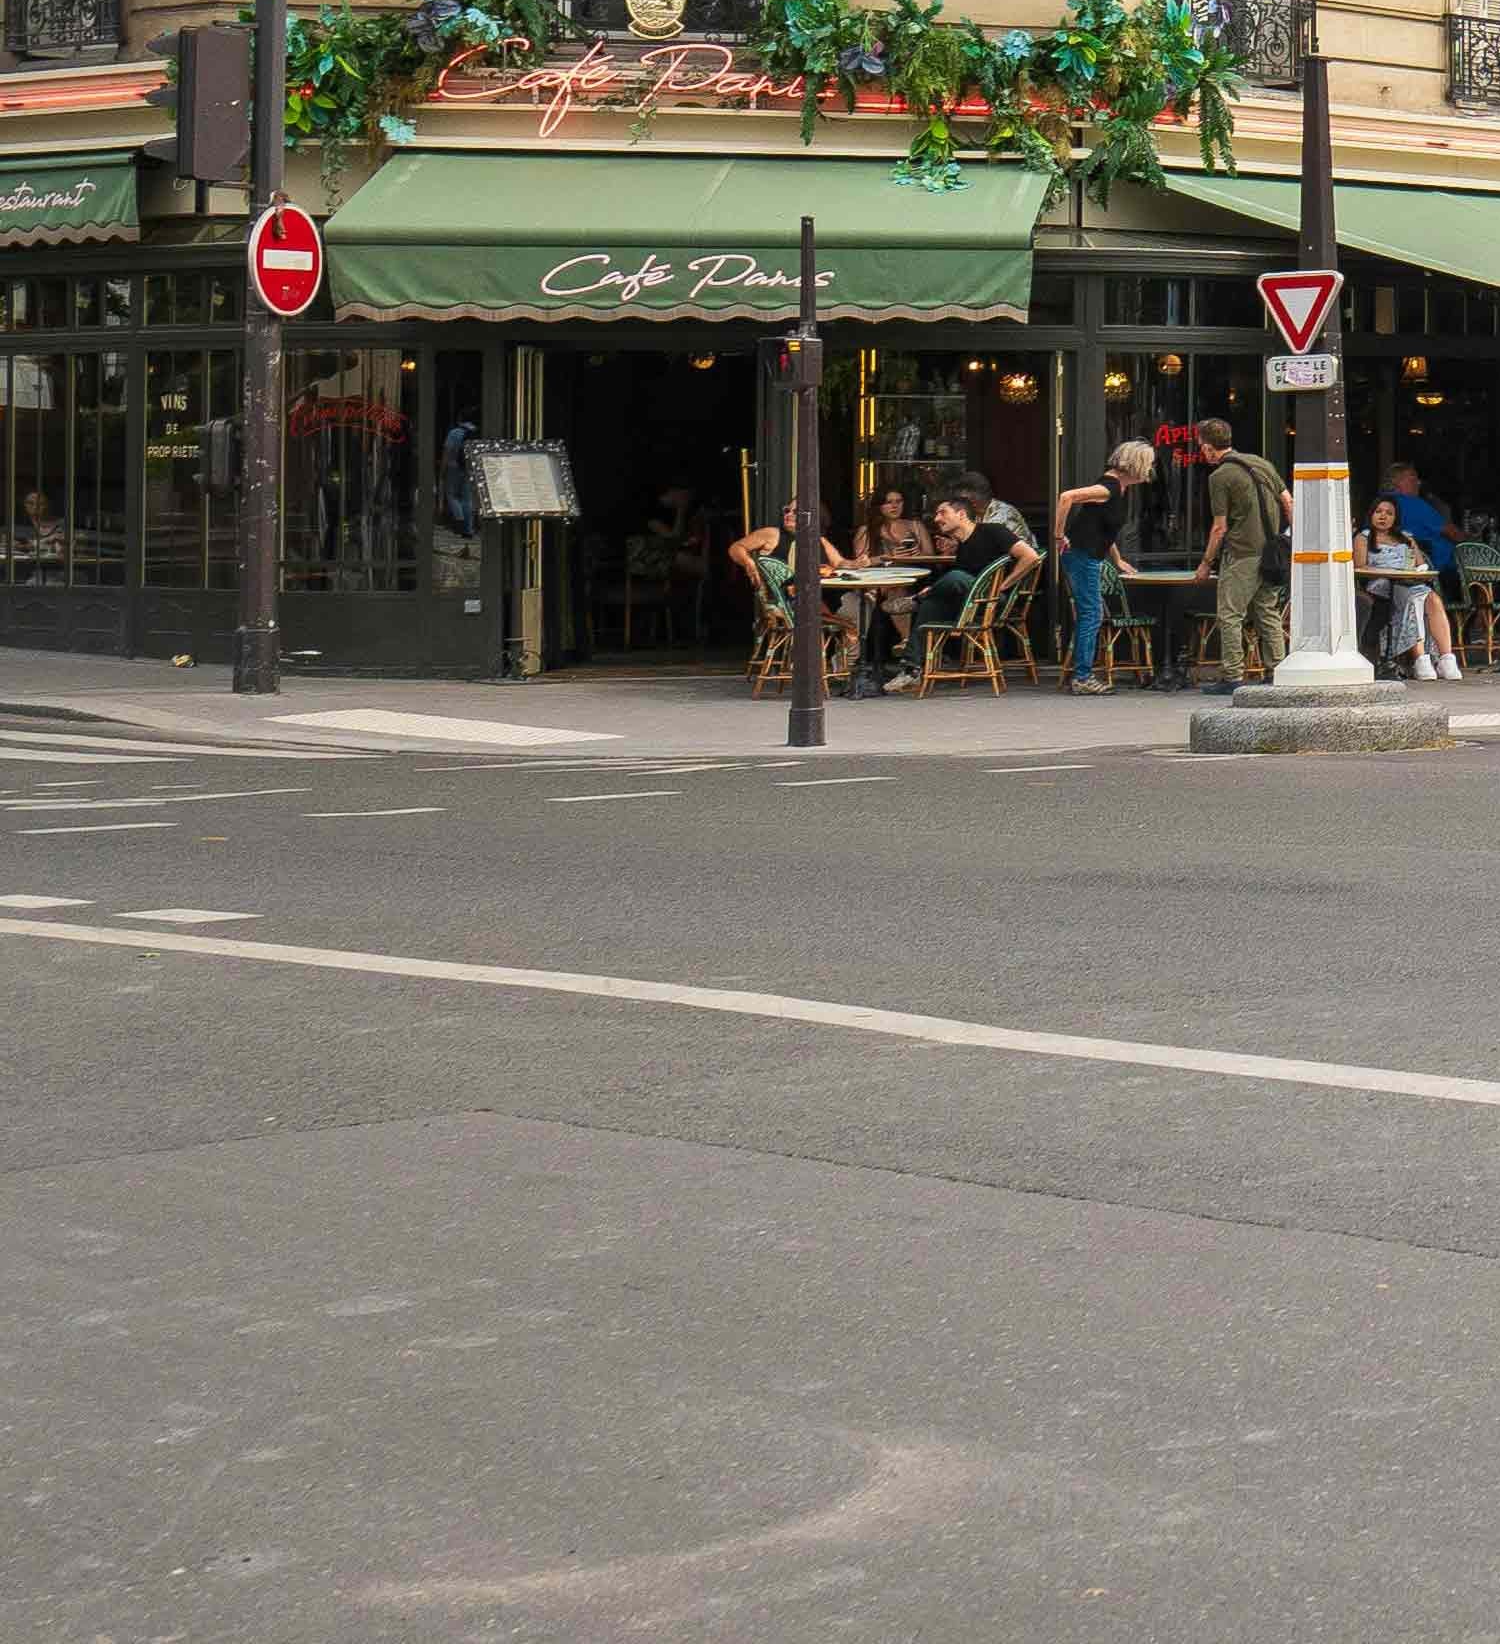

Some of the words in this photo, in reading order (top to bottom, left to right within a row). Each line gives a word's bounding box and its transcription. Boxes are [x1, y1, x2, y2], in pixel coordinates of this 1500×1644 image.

[437, 37, 622, 138] Café
[637, 43, 836, 112] Pari
[0, 177, 97, 211] estaurant
[540, 254, 674, 301] Café
[1314, 360, 1328, 371] LE
[160, 394, 187, 412] VINS
